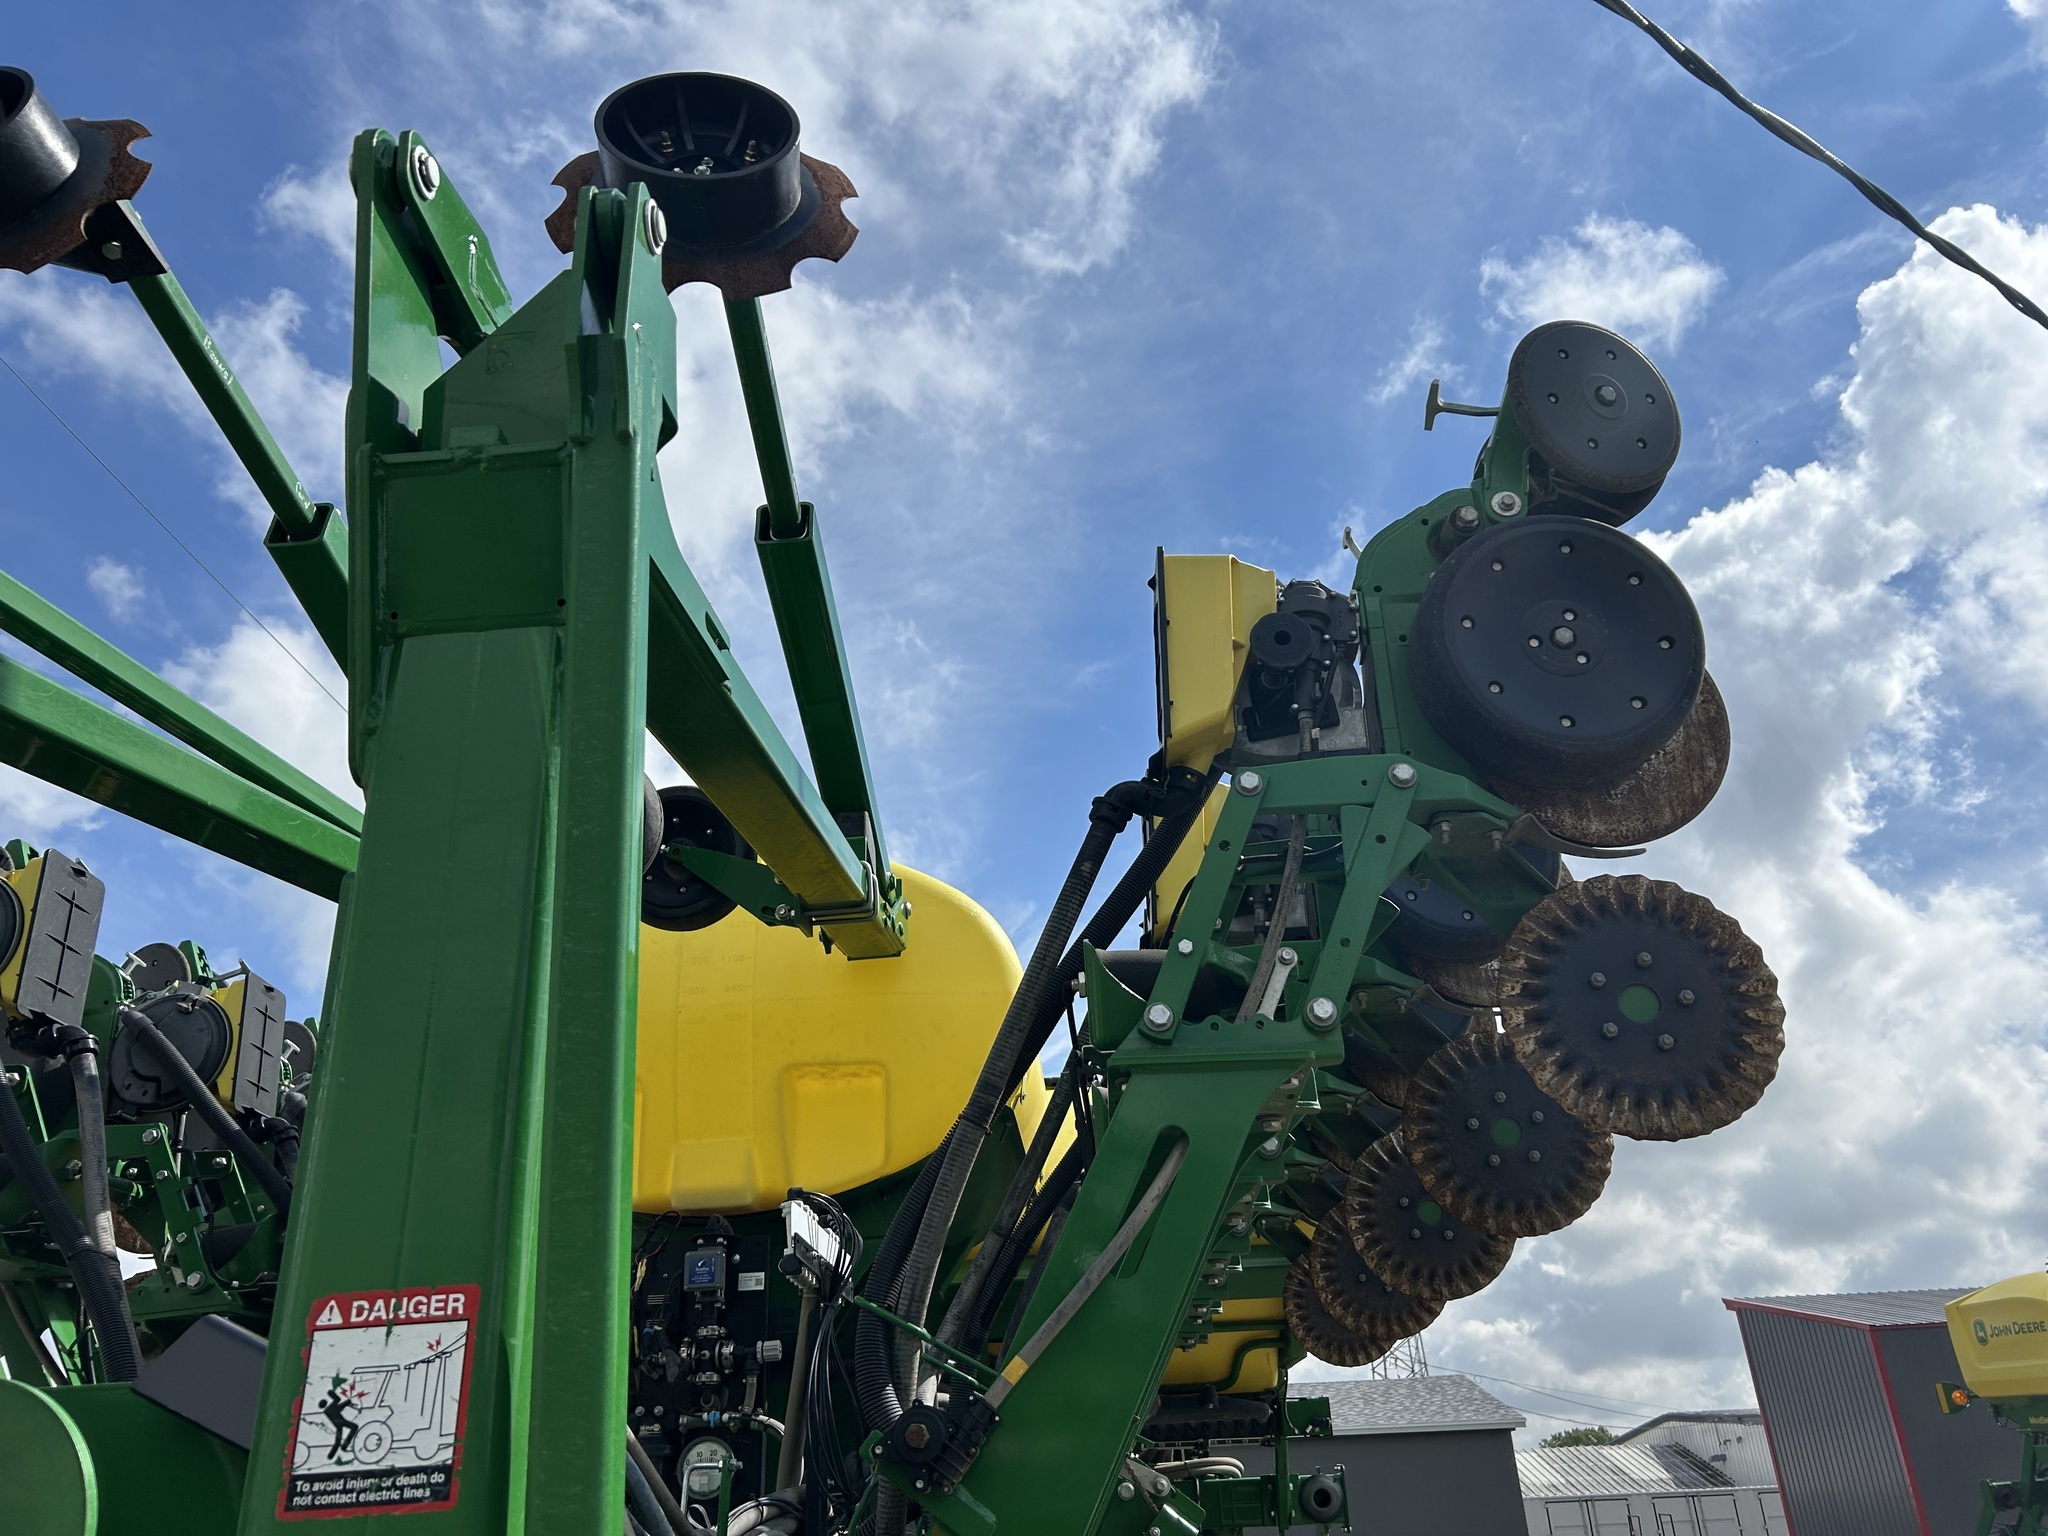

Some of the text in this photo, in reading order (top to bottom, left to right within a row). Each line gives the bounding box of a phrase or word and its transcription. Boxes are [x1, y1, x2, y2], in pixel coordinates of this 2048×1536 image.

[350, 1293, 466, 1322] DANGER
[1989, 1320, 2048, 1338] JOHN DEERE
[295, 1480, 310, 1492] To
[312, 1477, 344, 1491] avoid
[381, 1476, 395, 1488] or
[395, 1472, 427, 1486] death
[430, 1471, 445, 1484] do
[293, 1485, 431, 1506] not contact electric lines
